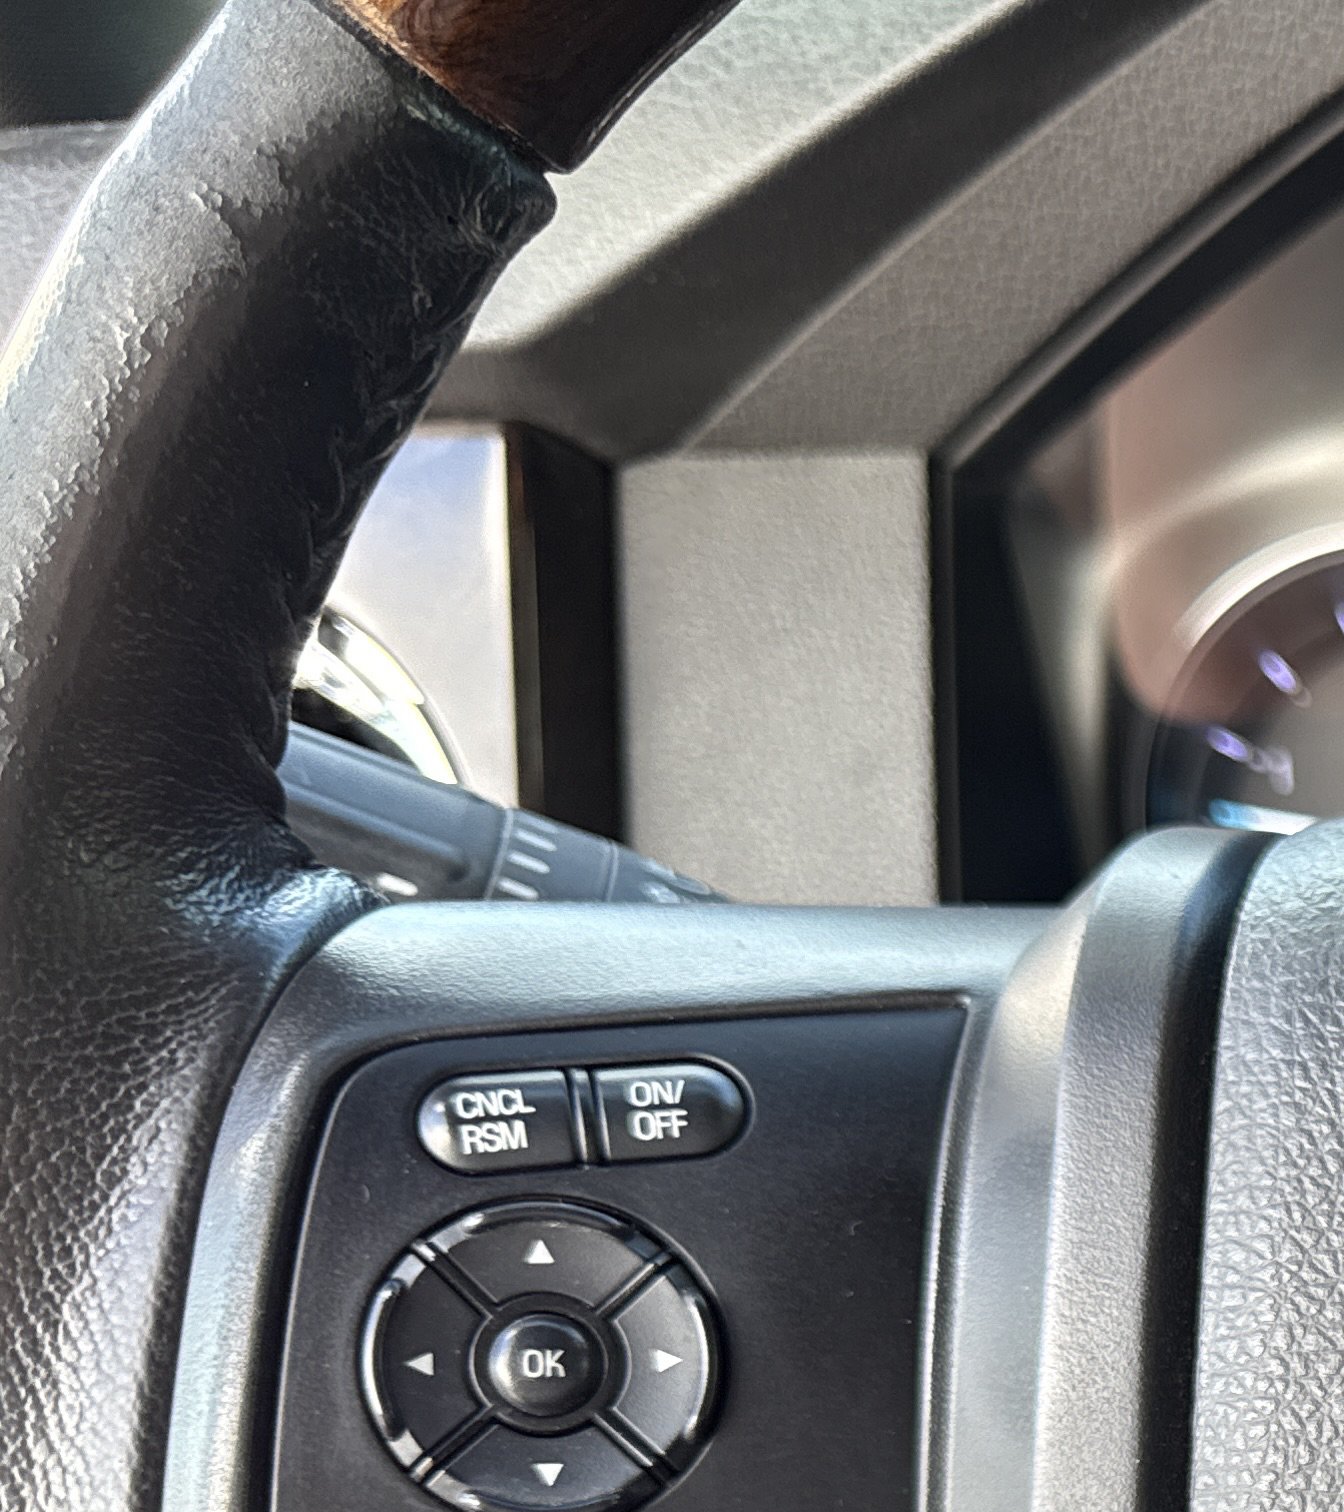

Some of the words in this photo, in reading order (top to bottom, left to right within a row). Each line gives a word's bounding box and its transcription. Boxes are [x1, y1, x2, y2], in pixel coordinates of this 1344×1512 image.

[454, 1089, 536, 1120] CNCL
[629, 1078, 685, 1107] ON/
[461, 1122, 529, 1155] RSM
[633, 1108, 689, 1141] OFF
[521, 1348, 566, 1380] OK
